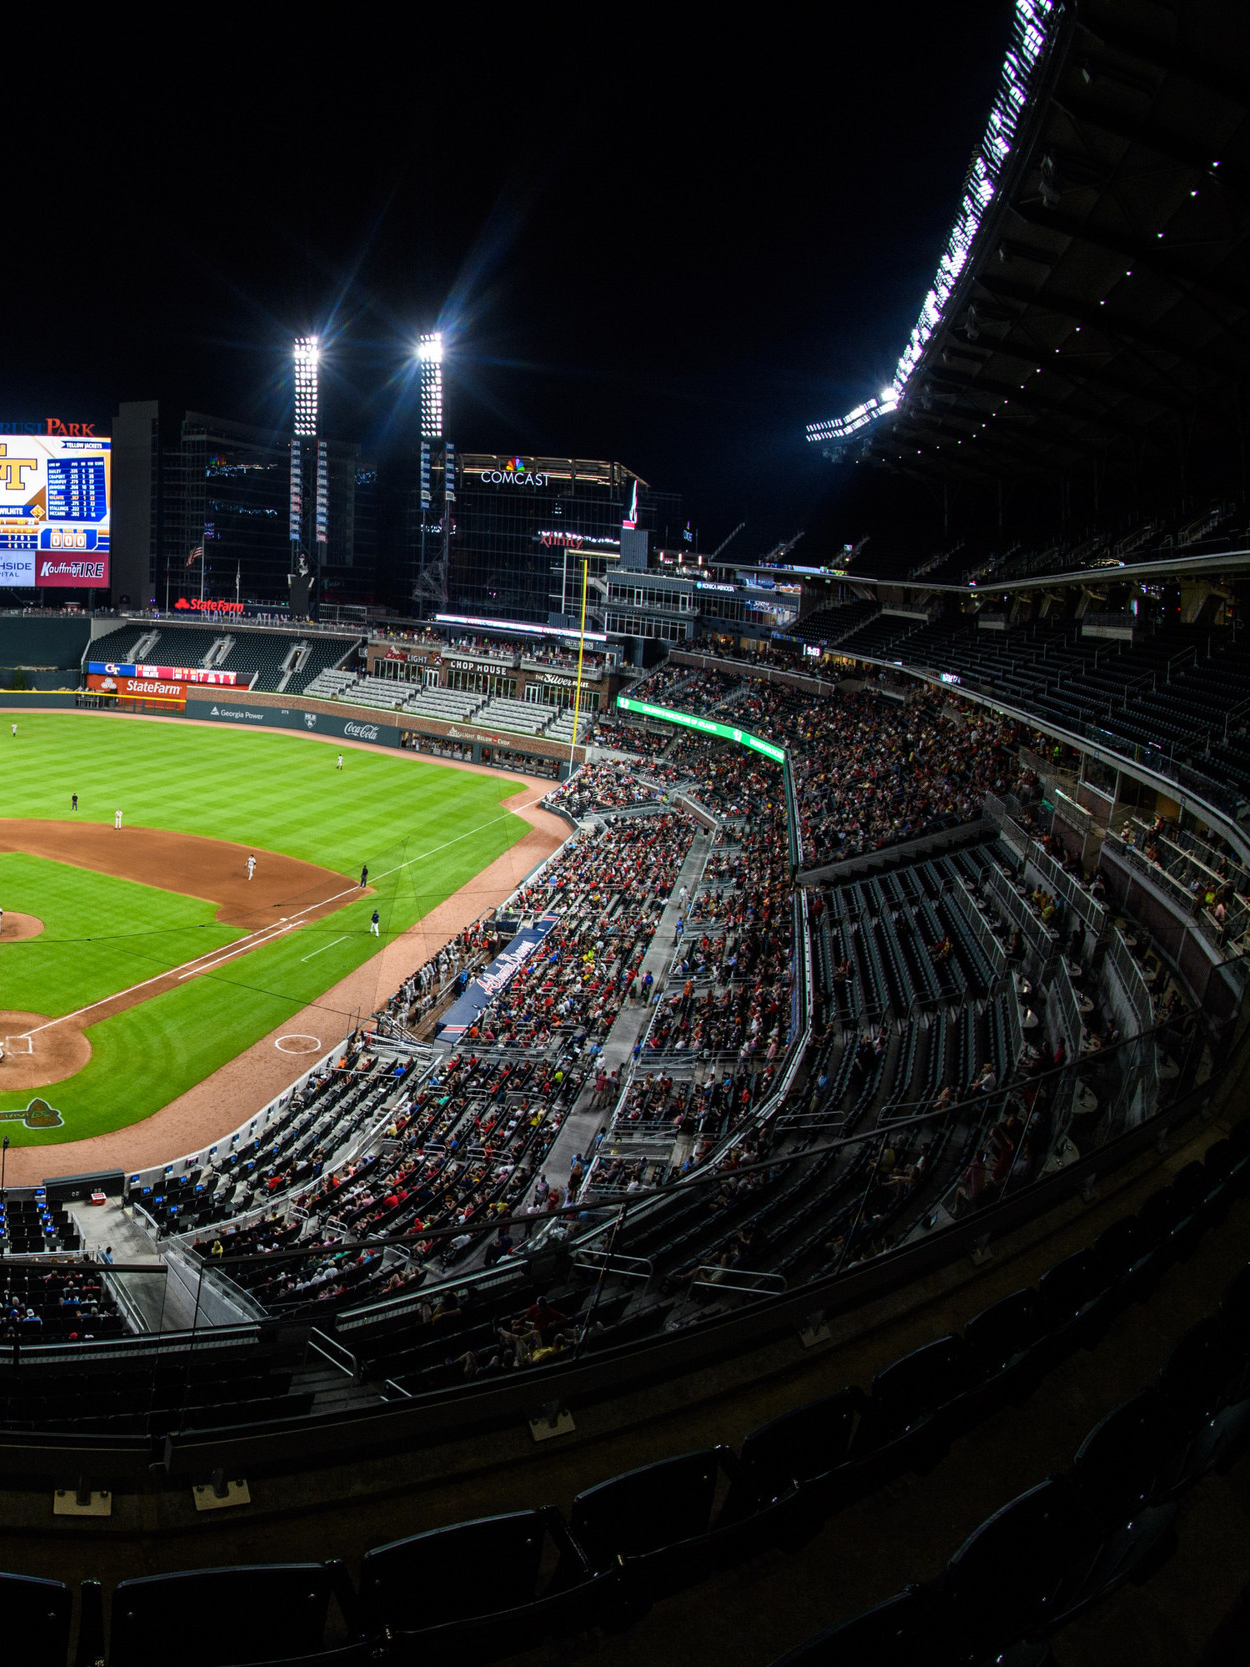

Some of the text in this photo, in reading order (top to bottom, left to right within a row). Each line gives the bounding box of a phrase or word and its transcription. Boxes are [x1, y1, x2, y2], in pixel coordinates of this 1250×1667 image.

[481, 471, 550, 486] COMCAST
[52, 536, 84, 546] 0 0 0
[540, 534, 583, 549] xfinity
[72, 563, 104, 578] TIRE
[407, 655, 428, 663] LIGHT
[451, 661, 507, 675] CHOP HOUSE
[544, 673, 571, 686] Silver
[220, 710, 244, 719] Georgia
[344, 721, 379, 740] Coca-Cola
[476, 940, 535, 996] Atlanta Braves
